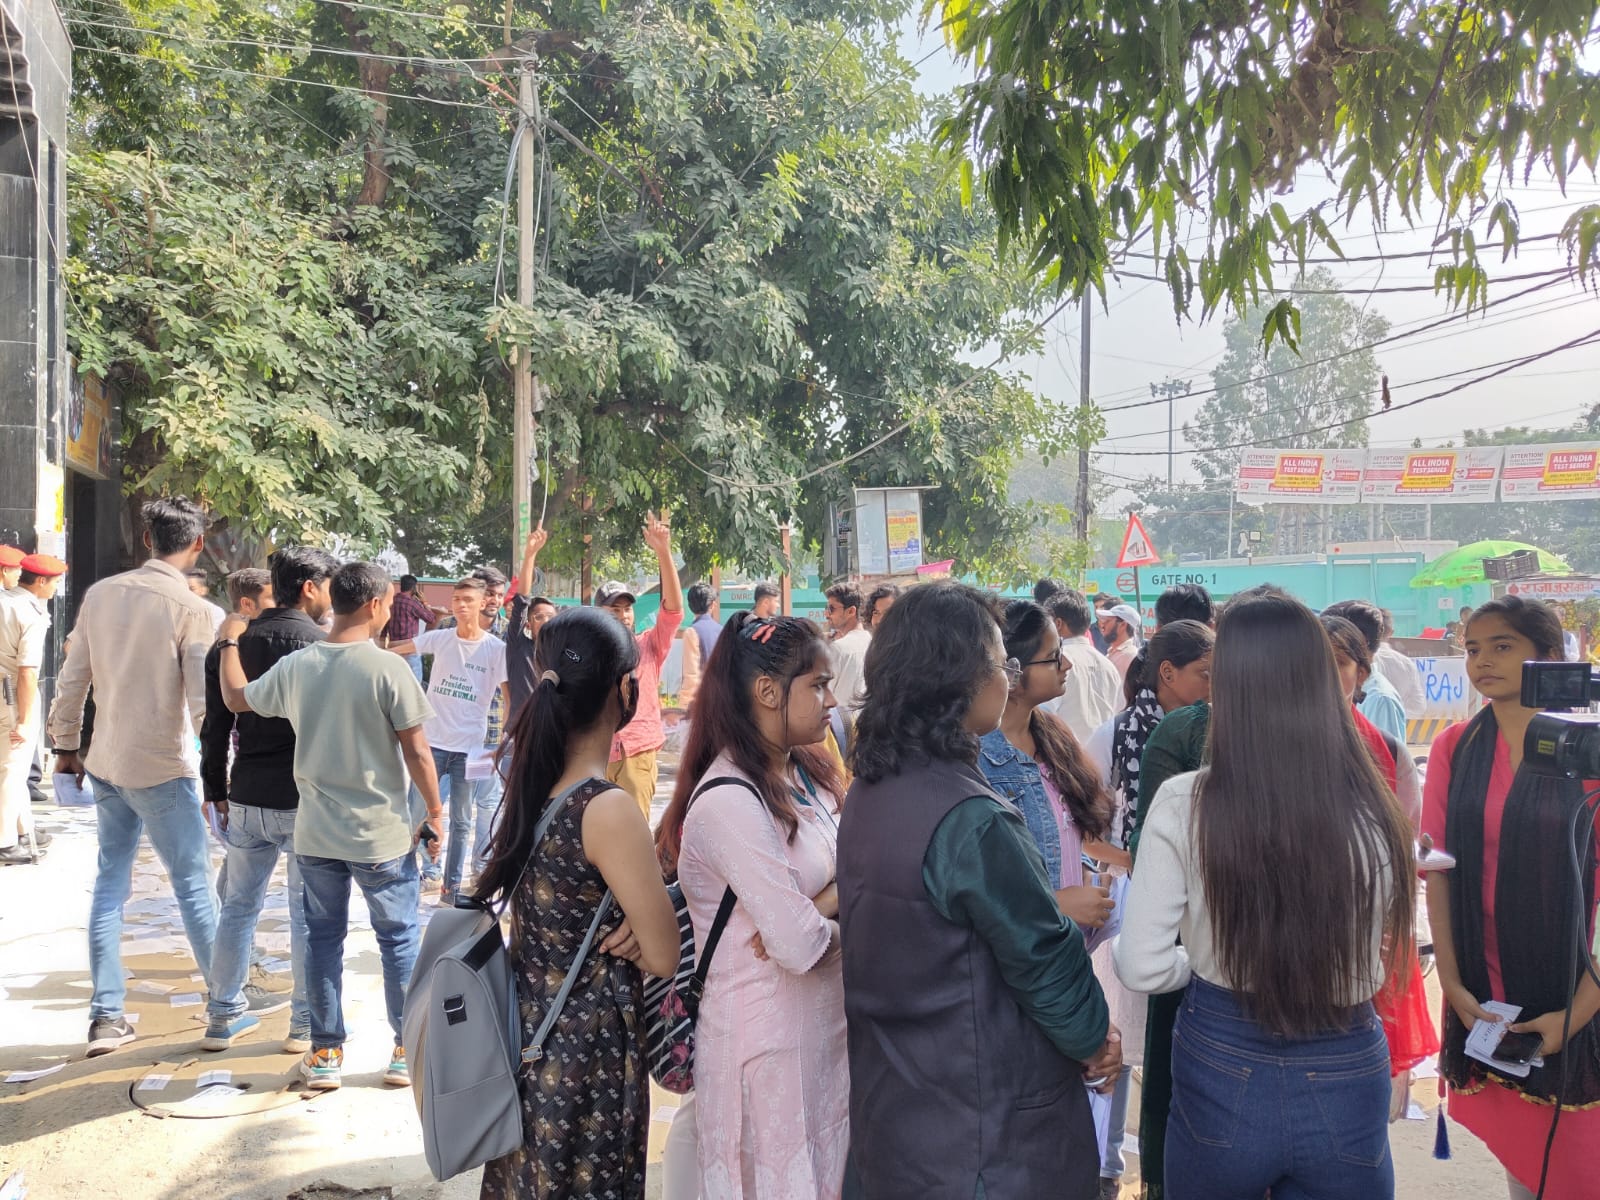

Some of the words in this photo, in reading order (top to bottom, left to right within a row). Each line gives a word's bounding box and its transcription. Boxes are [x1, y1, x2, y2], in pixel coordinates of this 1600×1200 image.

[1283, 459, 1296, 467] ALL
[1297, 459, 1318, 467] INDIA
[1412, 459, 1427, 467] ALL
[1427, 459, 1450, 467] INDIA
[1553, 455, 1568, 463] ALL
[1569, 454, 1593, 462] INDIA
[1152, 574, 1181, 585] GATE
[1185, 573, 1208, 585] NO.
[1212, 573, 1217, 585] 1
[441, 678, 473, 692] President
[1426, 672, 1463, 702] RAJ
